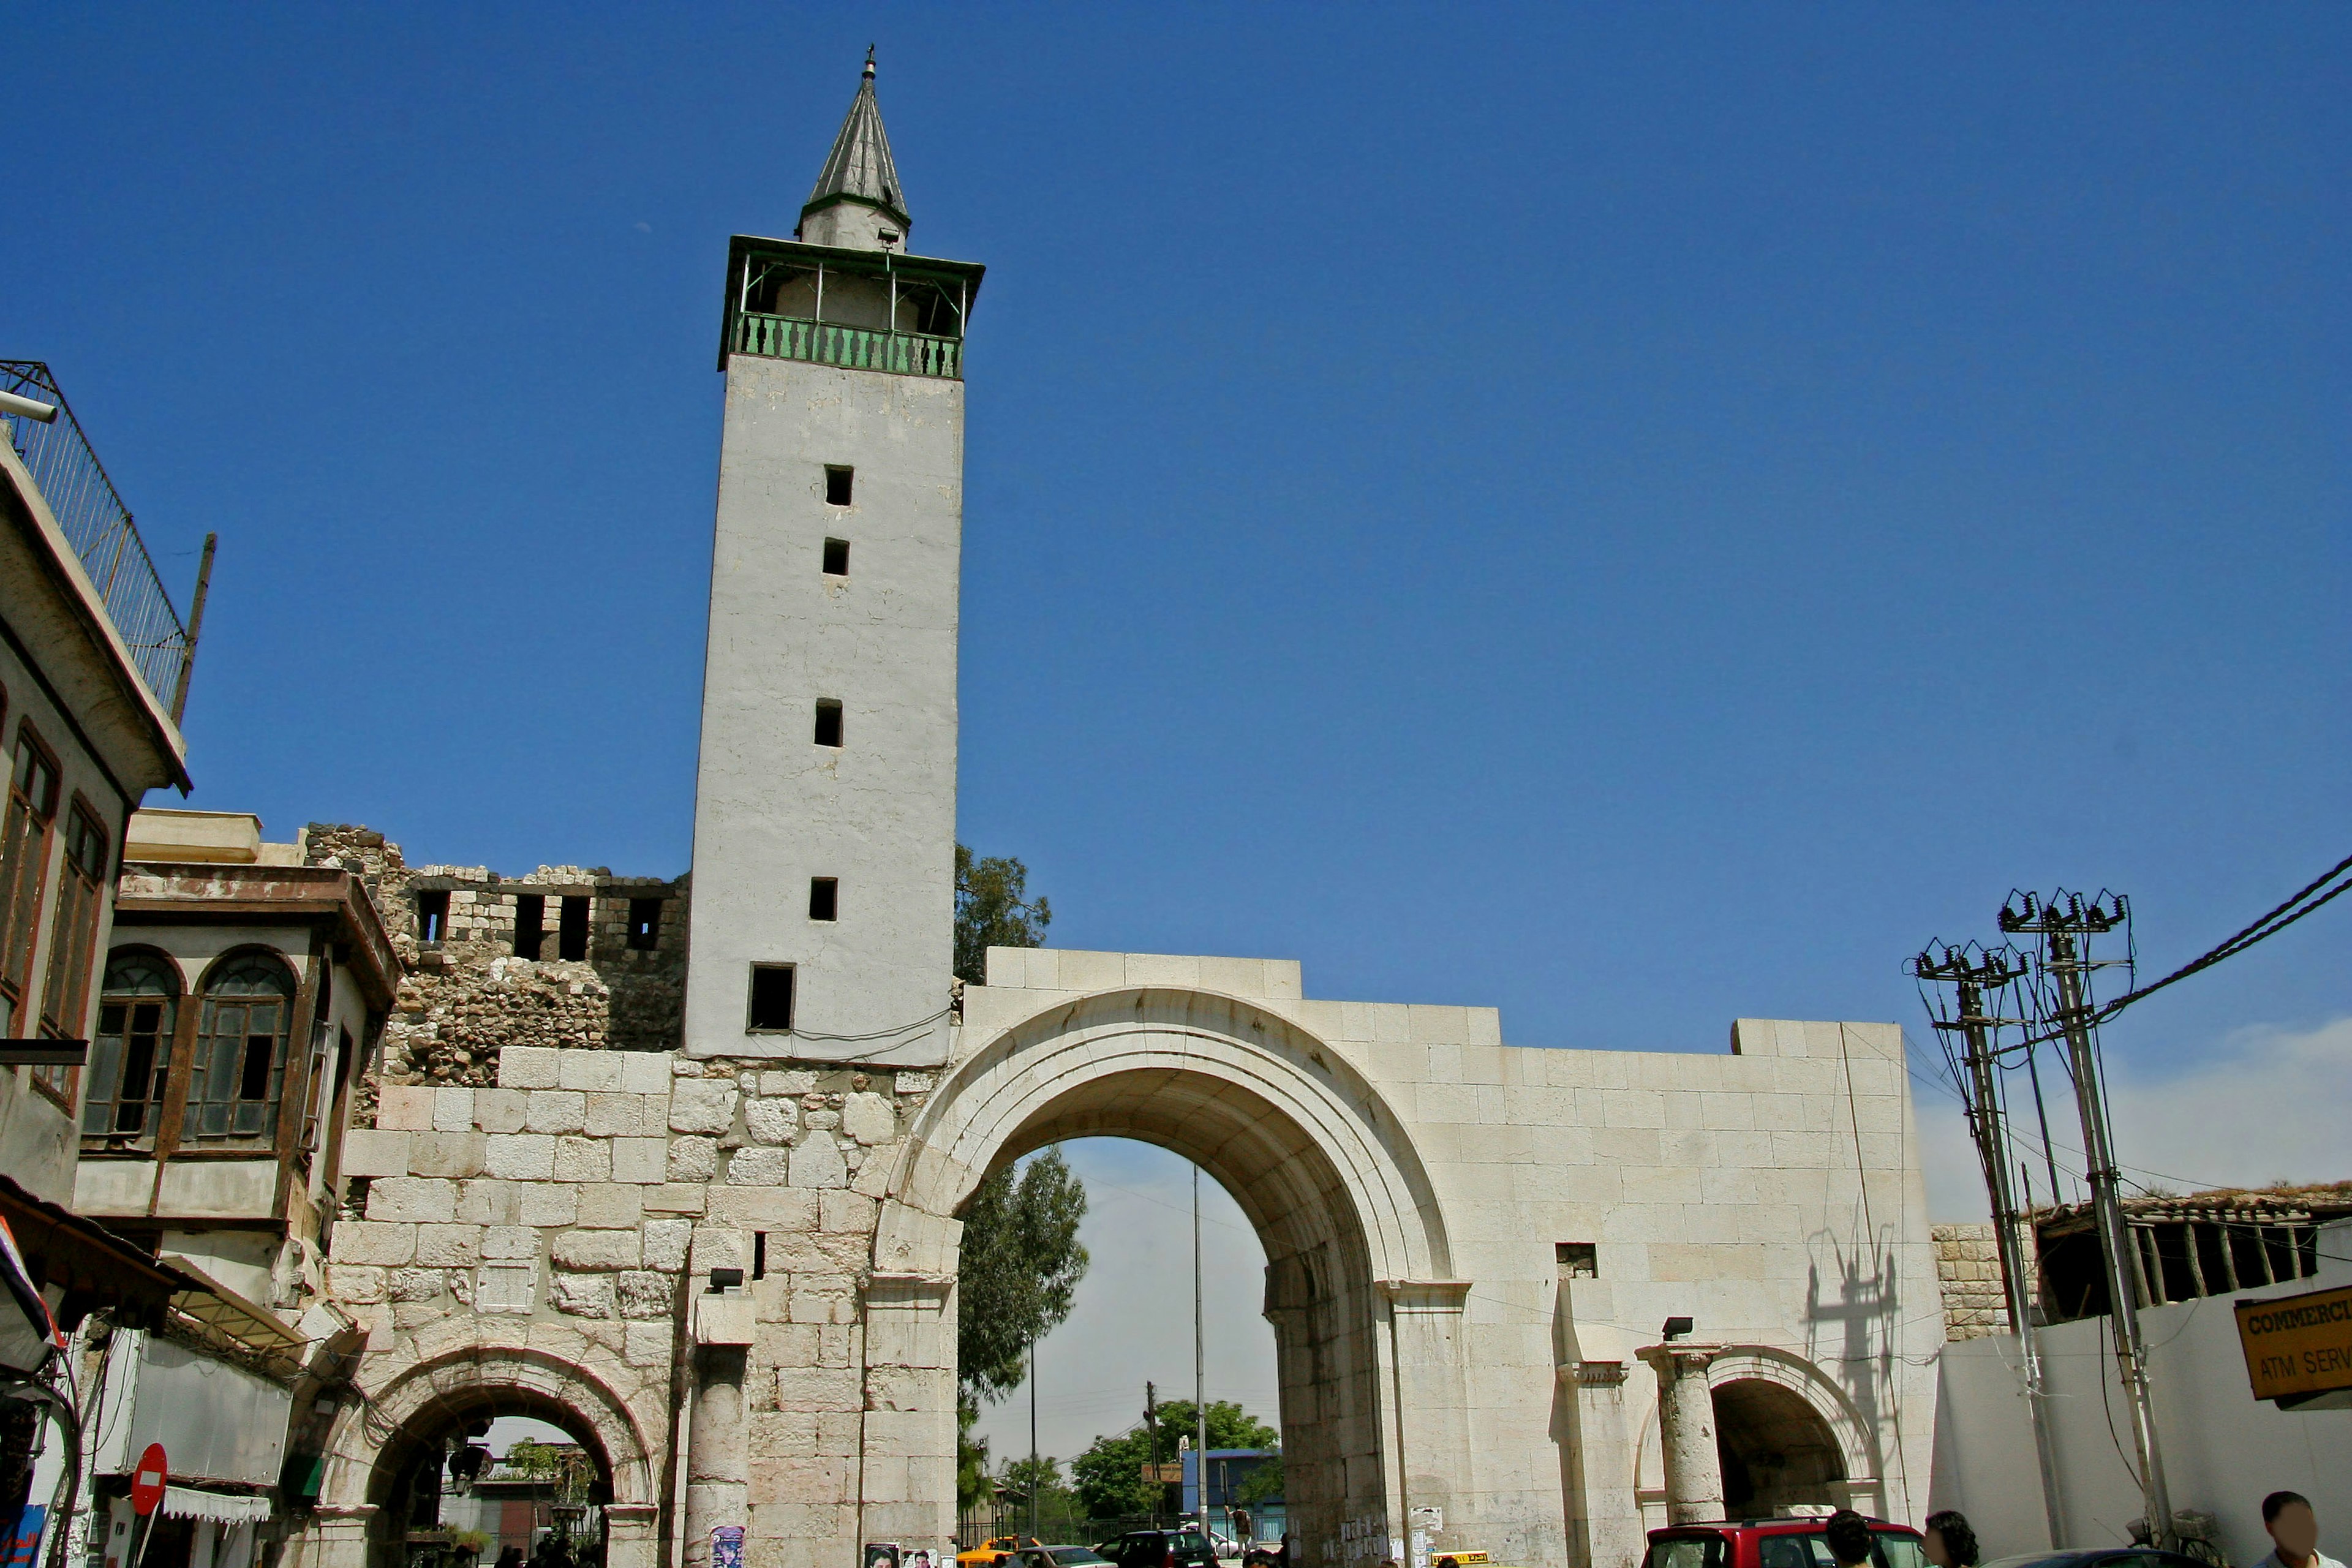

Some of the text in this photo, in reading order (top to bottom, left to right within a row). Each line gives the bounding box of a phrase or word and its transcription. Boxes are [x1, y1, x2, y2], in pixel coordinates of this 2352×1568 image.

[2248, 1298, 2352, 1335] COMMERCI
[2261, 1345, 2352, 1379] ATM SERV
